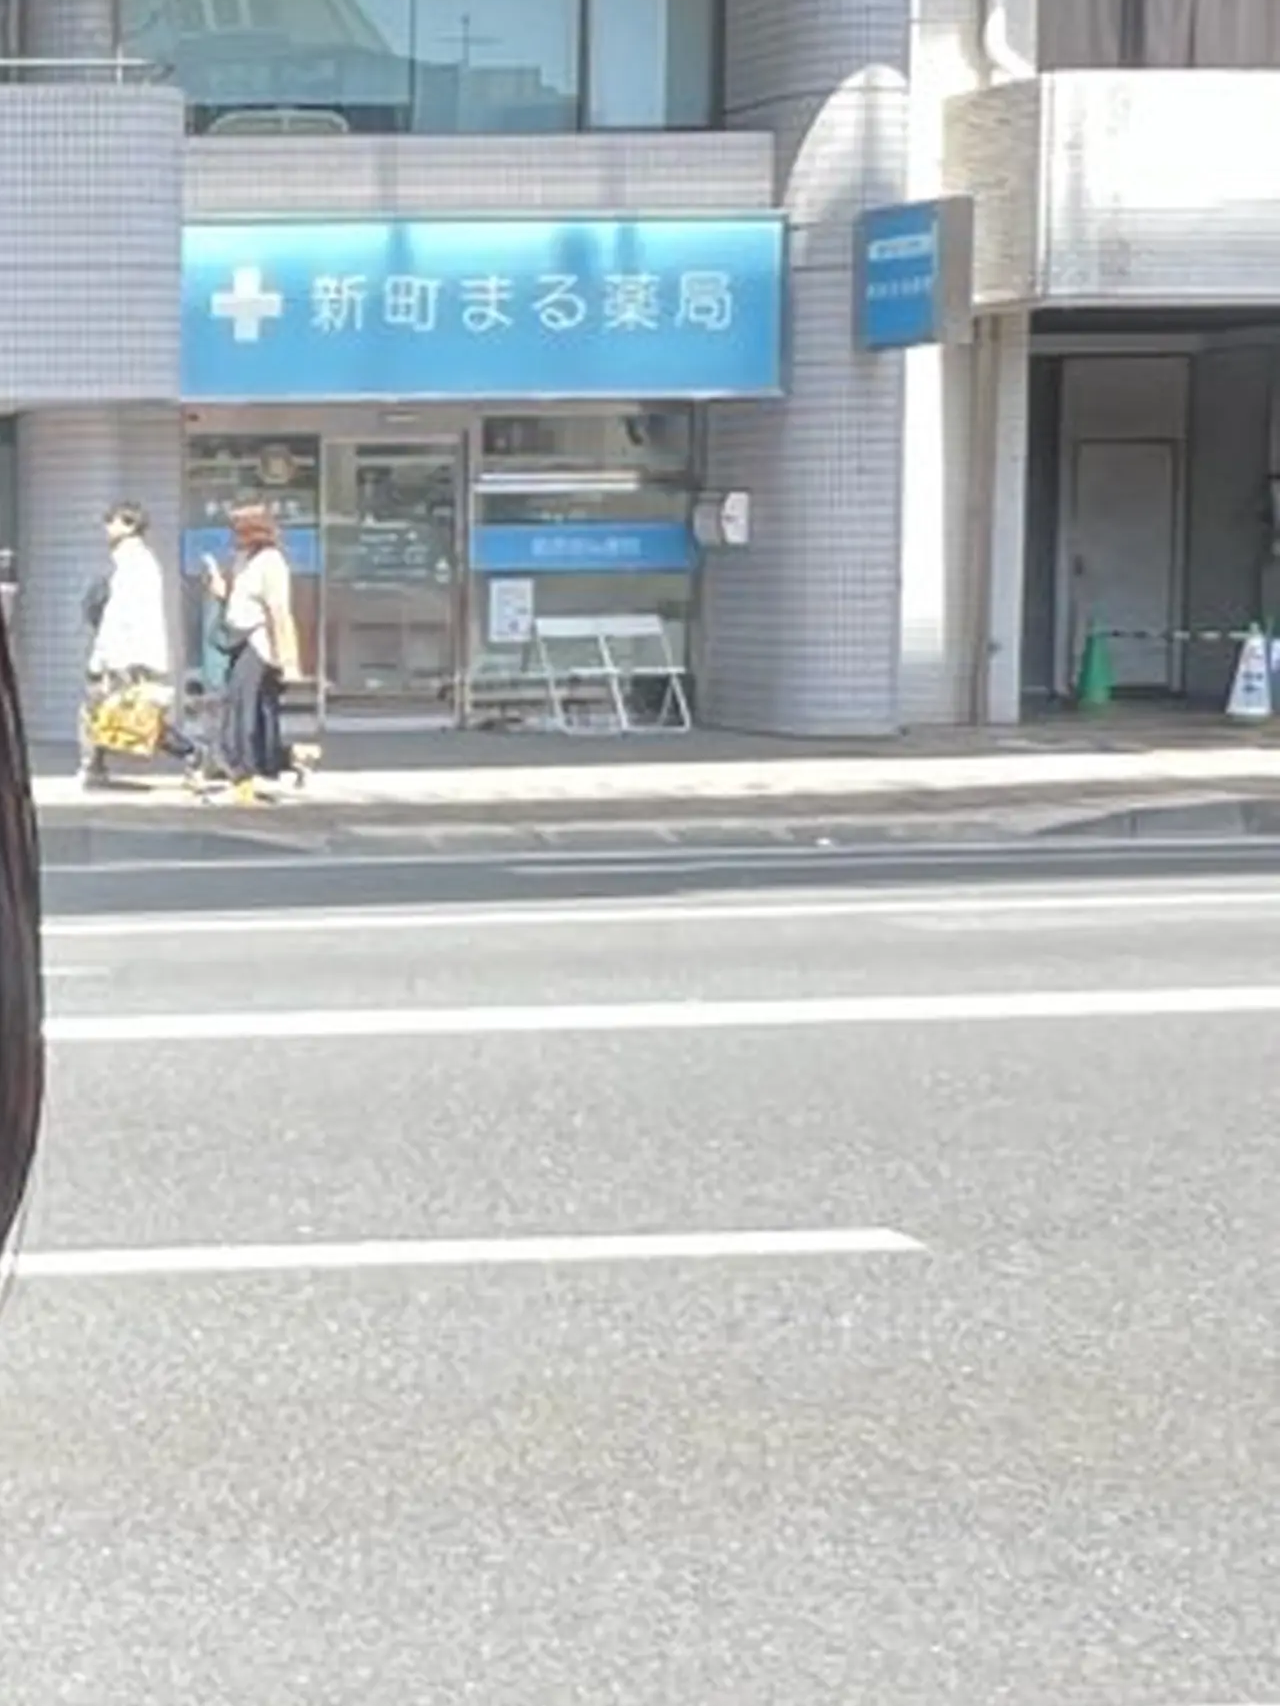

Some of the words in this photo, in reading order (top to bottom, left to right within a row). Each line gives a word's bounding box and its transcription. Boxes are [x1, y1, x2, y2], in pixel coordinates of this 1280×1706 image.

[309, 270, 735, 332] 新町まる薬局
